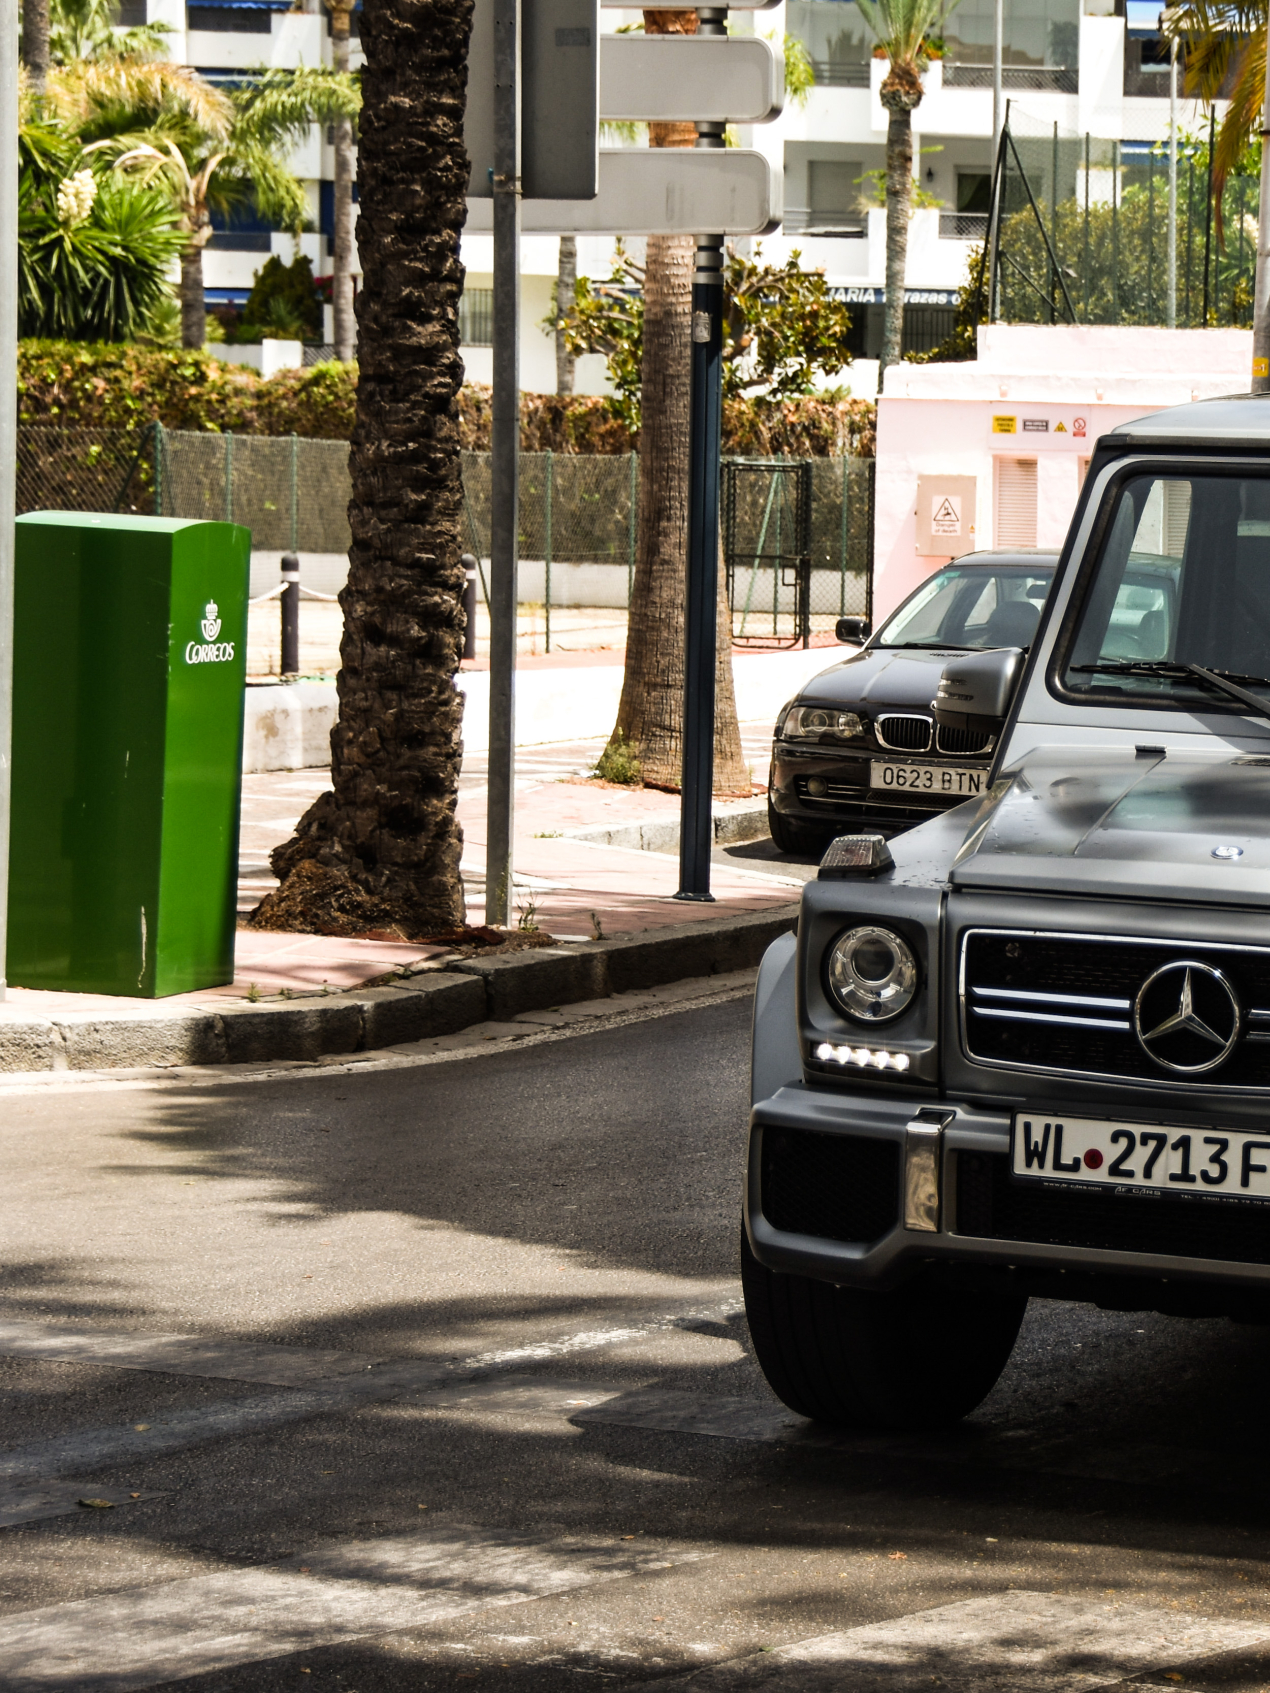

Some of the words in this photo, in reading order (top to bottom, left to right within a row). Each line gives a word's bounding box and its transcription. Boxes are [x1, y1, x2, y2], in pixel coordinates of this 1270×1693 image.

[186, 641, 235, 664] CORREOS
[883, 766, 933, 788] 0623
[941, 771, 980, 792] BTN
[1024, 1121, 1081, 1172] WL
[1108, 1129, 1229, 1184] 2713
